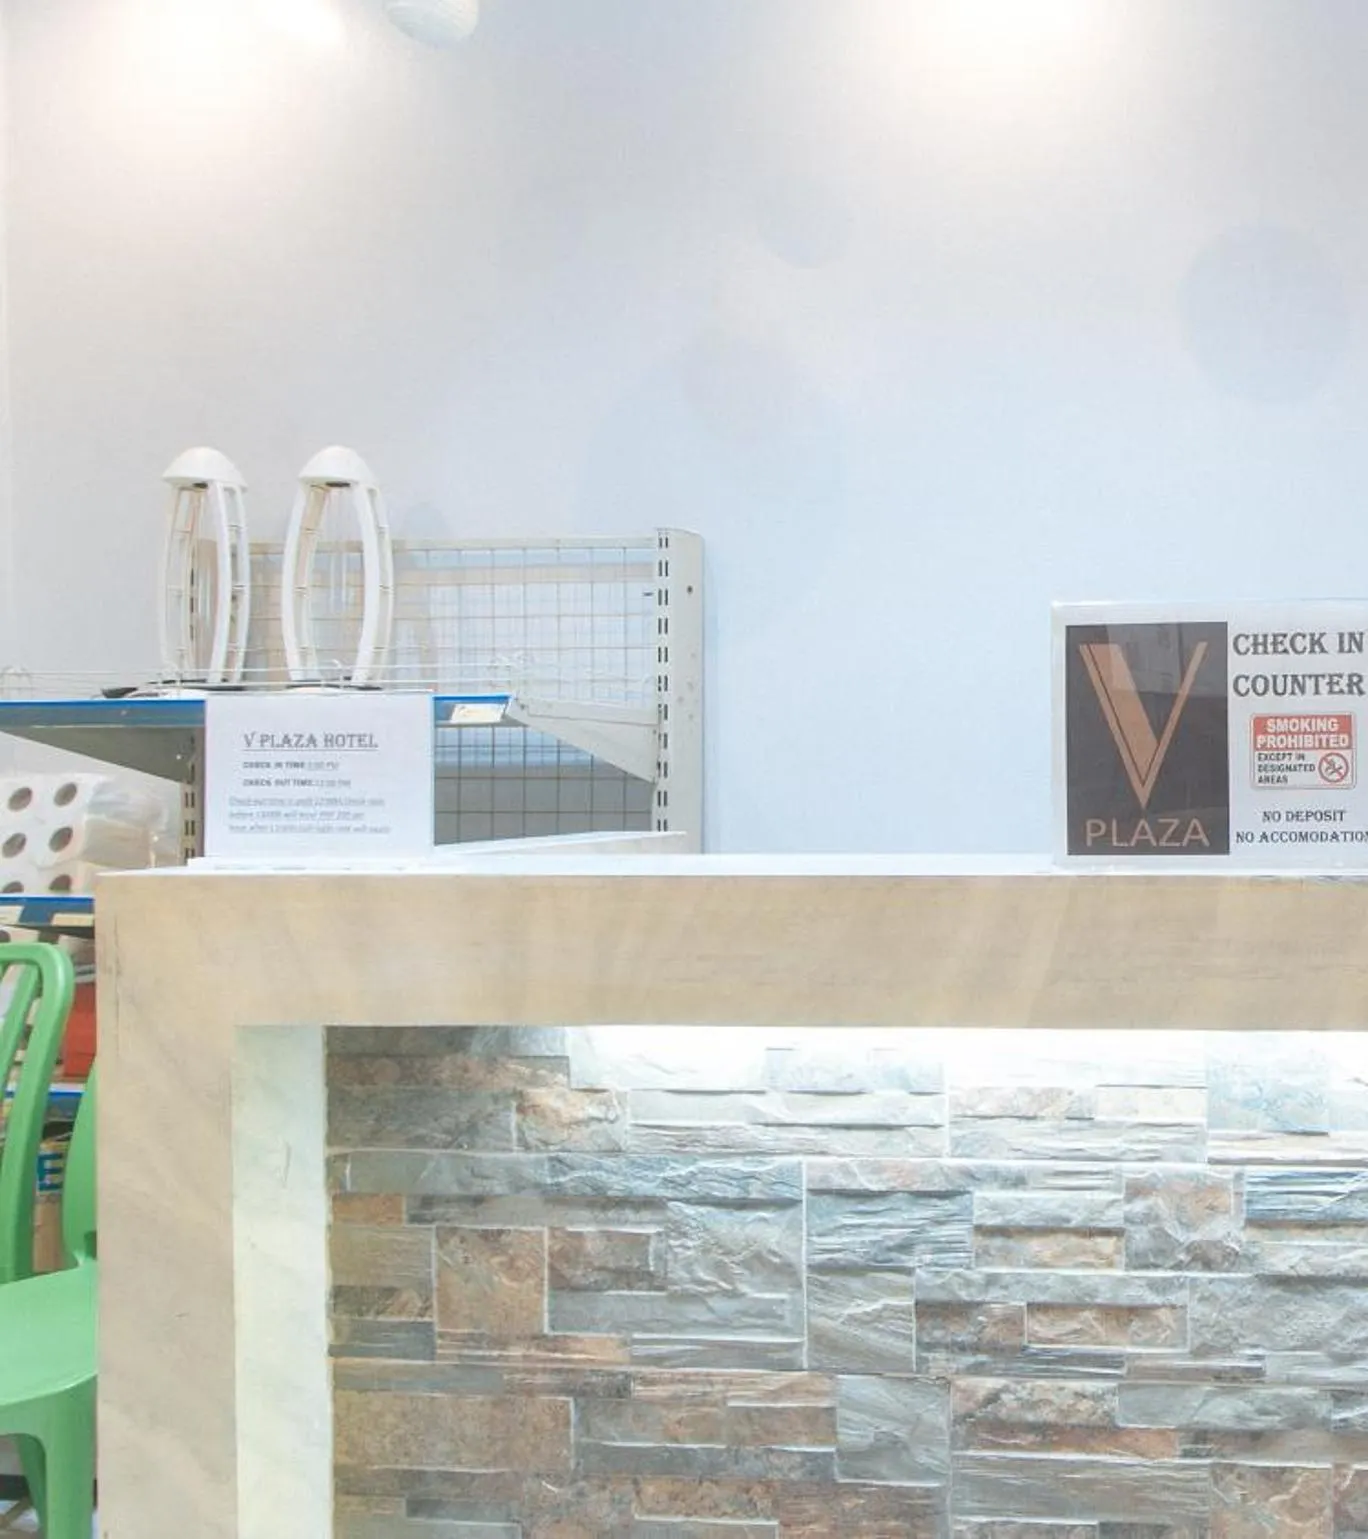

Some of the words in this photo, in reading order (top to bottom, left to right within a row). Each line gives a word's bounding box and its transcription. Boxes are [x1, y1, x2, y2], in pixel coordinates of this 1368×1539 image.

[1233, 632, 1328, 655] CHECK
[1337, 631, 1365, 654] IN
[1233, 673, 1366, 697] COUNTER
[1265, 717, 1340, 733] SMOKING
[243, 731, 257, 748] V
[260, 733, 318, 748] PLAZA
[324, 733, 379, 748] HOTEL
[1256, 733, 1350, 749] PROHIBITED
[1257, 752, 1293, 762] EXCEPT
[1295, 752, 1306, 761] IN
[1257, 763, 1317, 773] DESIGNATED
[1257, 775, 1289, 785] AREAS
[1262, 810, 1281, 823] NO
[1285, 809, 1346, 822] DEPOSIT
[1086, 818, 1210, 848] PLAZA
[1236, 831, 1254, 843] NO
